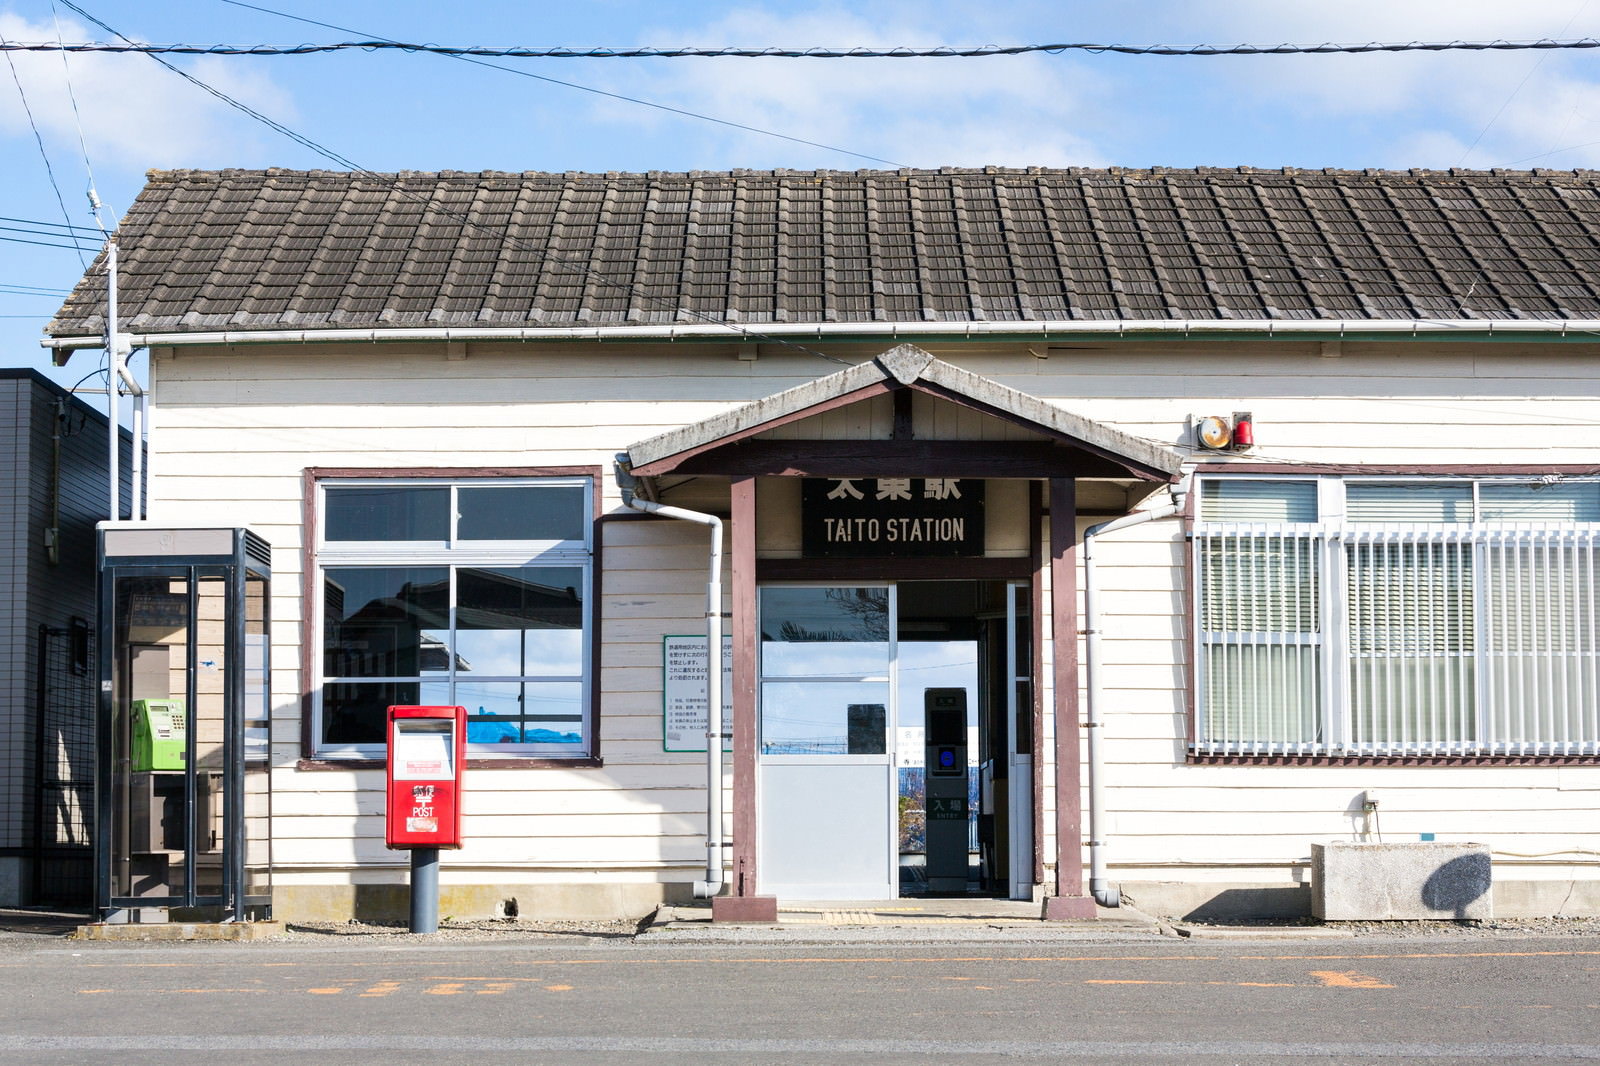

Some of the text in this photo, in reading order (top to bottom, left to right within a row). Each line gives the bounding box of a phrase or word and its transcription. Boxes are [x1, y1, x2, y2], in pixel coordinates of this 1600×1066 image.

[827, 478, 962, 500] 太東駅
[824, 518, 964, 542] TAITO STATION
[413, 807, 434, 817] POST
[933, 800, 961, 811] 入場
